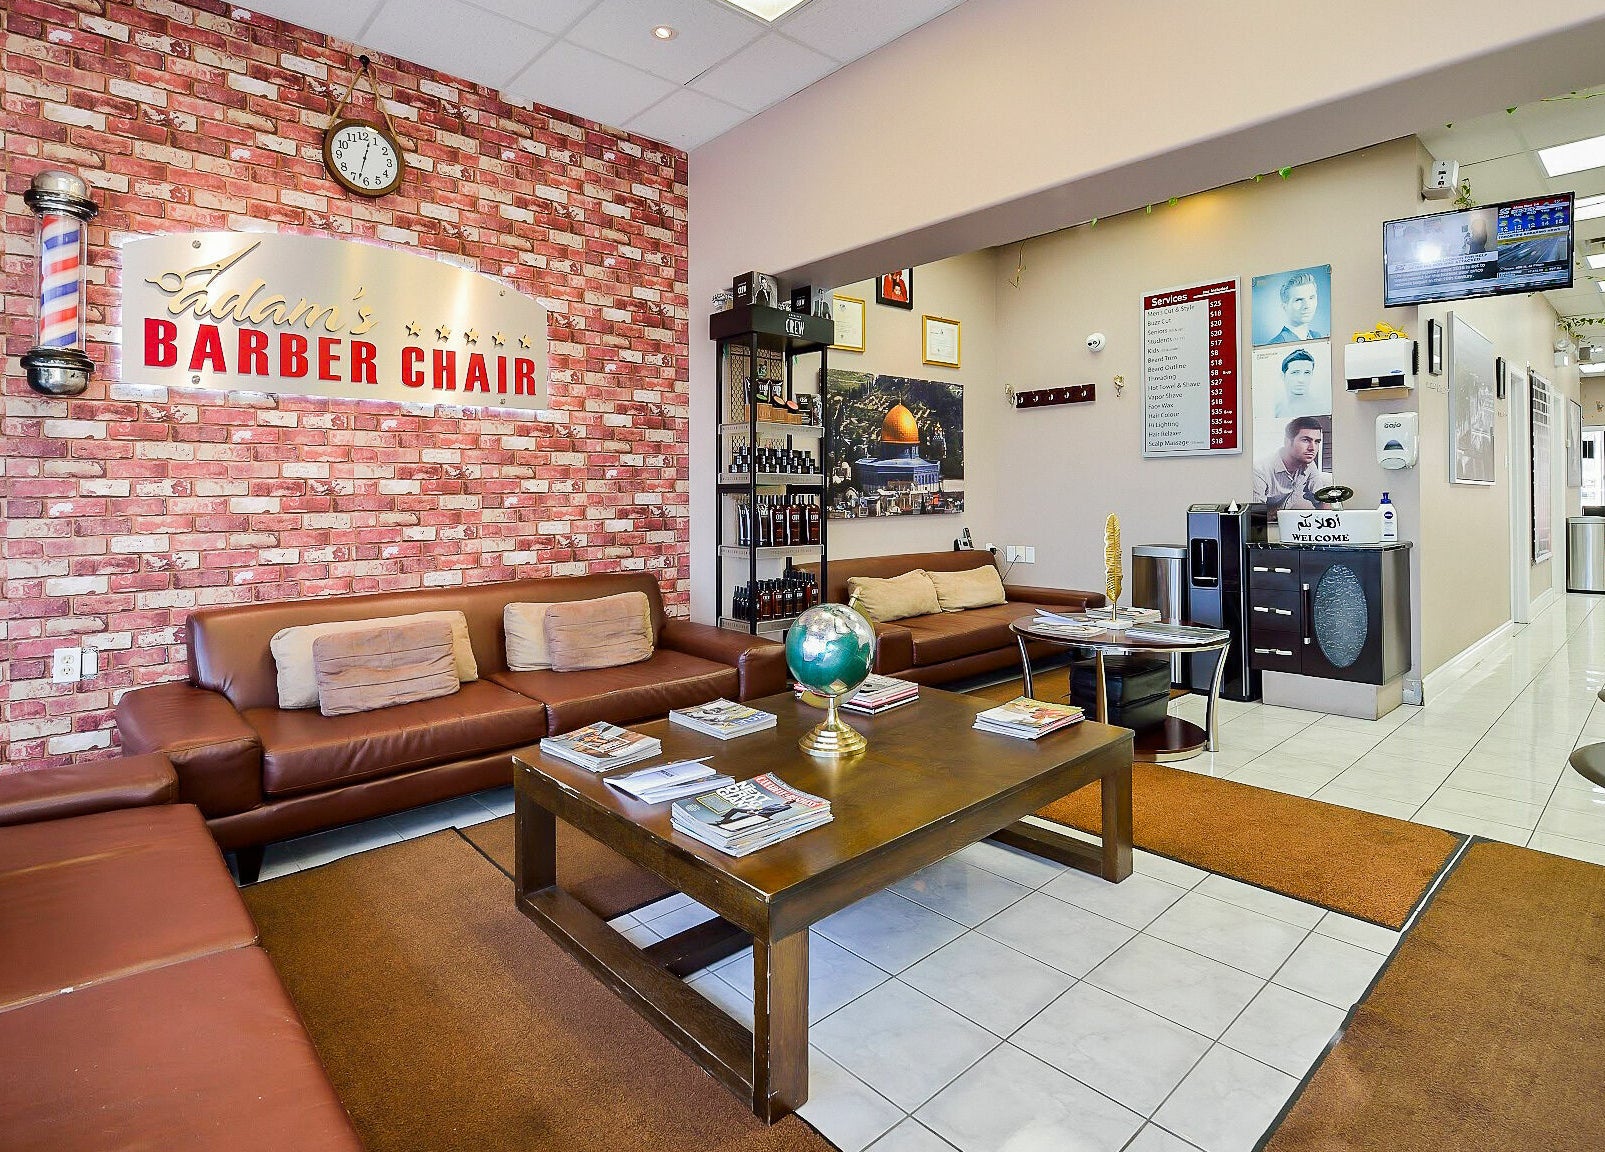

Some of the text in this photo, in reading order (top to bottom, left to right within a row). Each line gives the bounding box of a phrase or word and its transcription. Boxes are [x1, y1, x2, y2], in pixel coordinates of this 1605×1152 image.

[347, 133, 357, 142] 11
[358, 132, 368, 141] 12
[338, 140, 348, 149] 10
[373, 138, 378, 146] 1
[336, 150, 342, 159] 9
[382, 147, 388, 155] 2
[341, 162, 347, 171] 8
[387, 159, 392, 167] 3
[351, 172, 356, 180] 7
[383, 170, 389, 178] 4
[363, 177, 369, 186] 6
[375, 176, 381, 185] 5
[1151, 294, 1188, 307] Services
[786, 319, 804, 336] CREW
[144, 316, 537, 396] BARBER CHAIR
[1292, 533, 1350, 542] WELCOME
[735, 780, 772, 802] NEXT
[725, 784, 763, 808] DRUG
